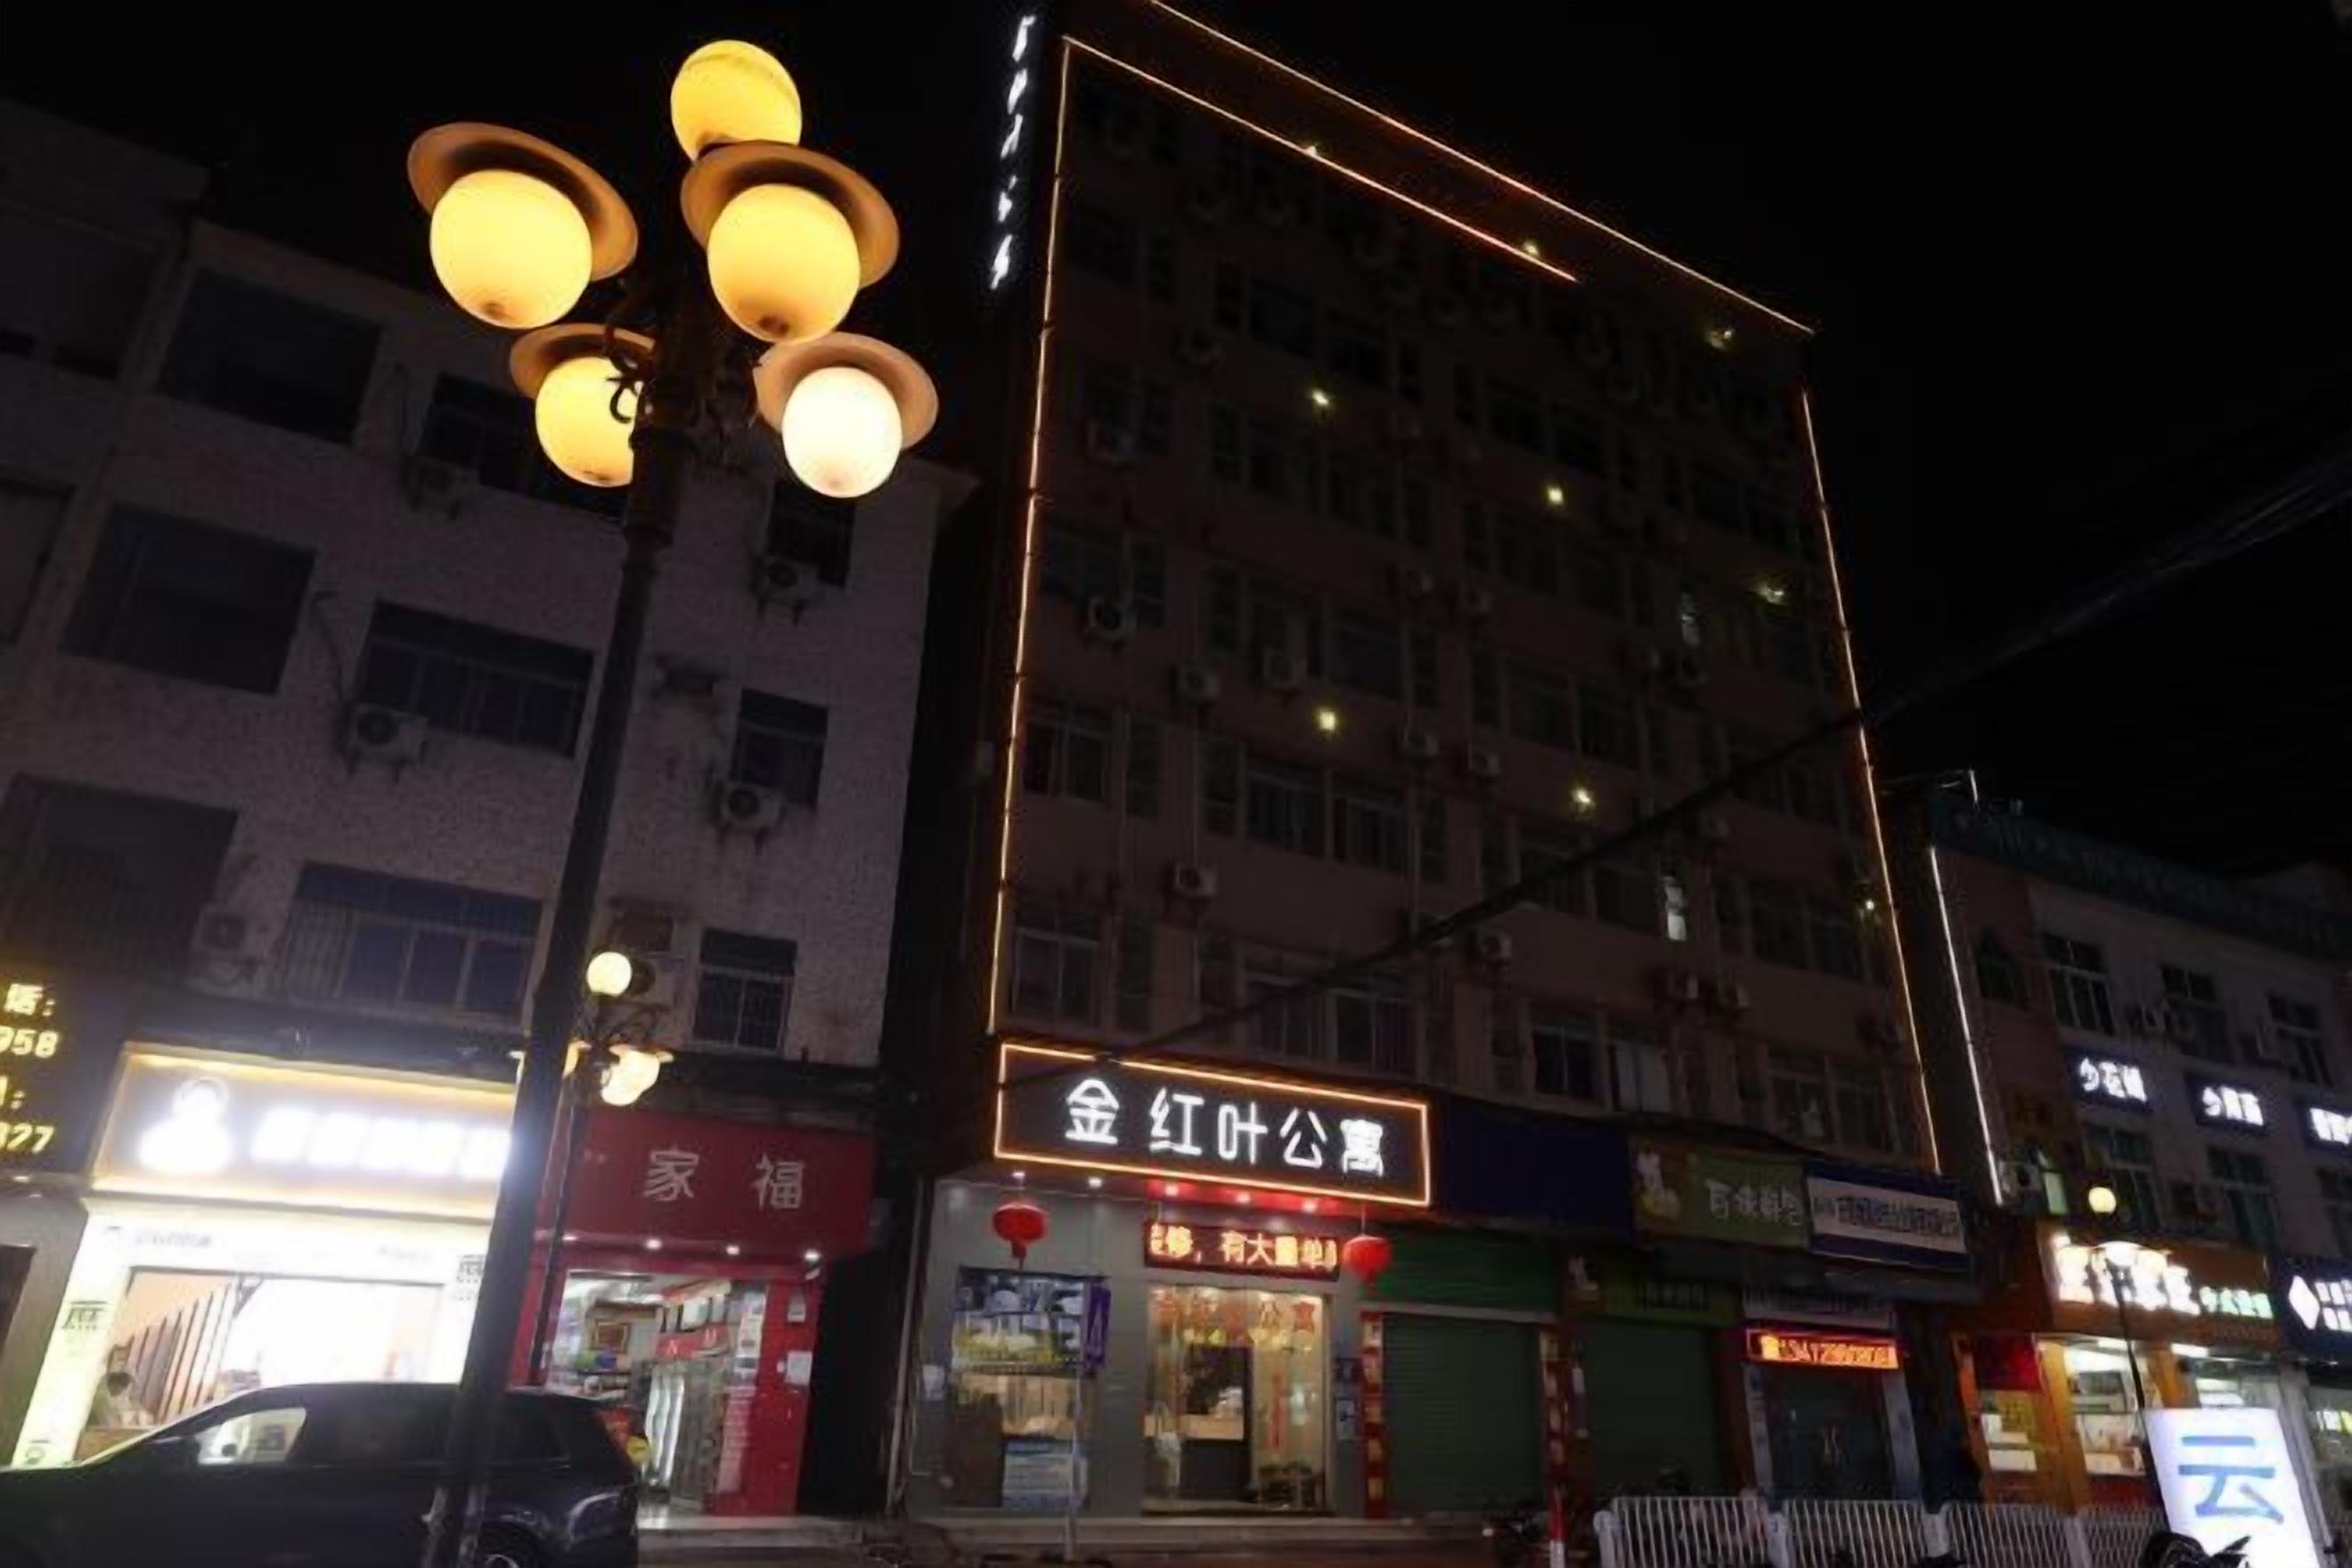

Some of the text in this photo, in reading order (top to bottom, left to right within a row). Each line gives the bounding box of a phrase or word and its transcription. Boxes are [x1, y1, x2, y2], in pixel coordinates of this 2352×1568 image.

[1065, 1078, 1384, 1178] 金红叶公寓
[643, 1145, 805, 1211] 家福
[2178, 1436, 2283, 1523] 云
